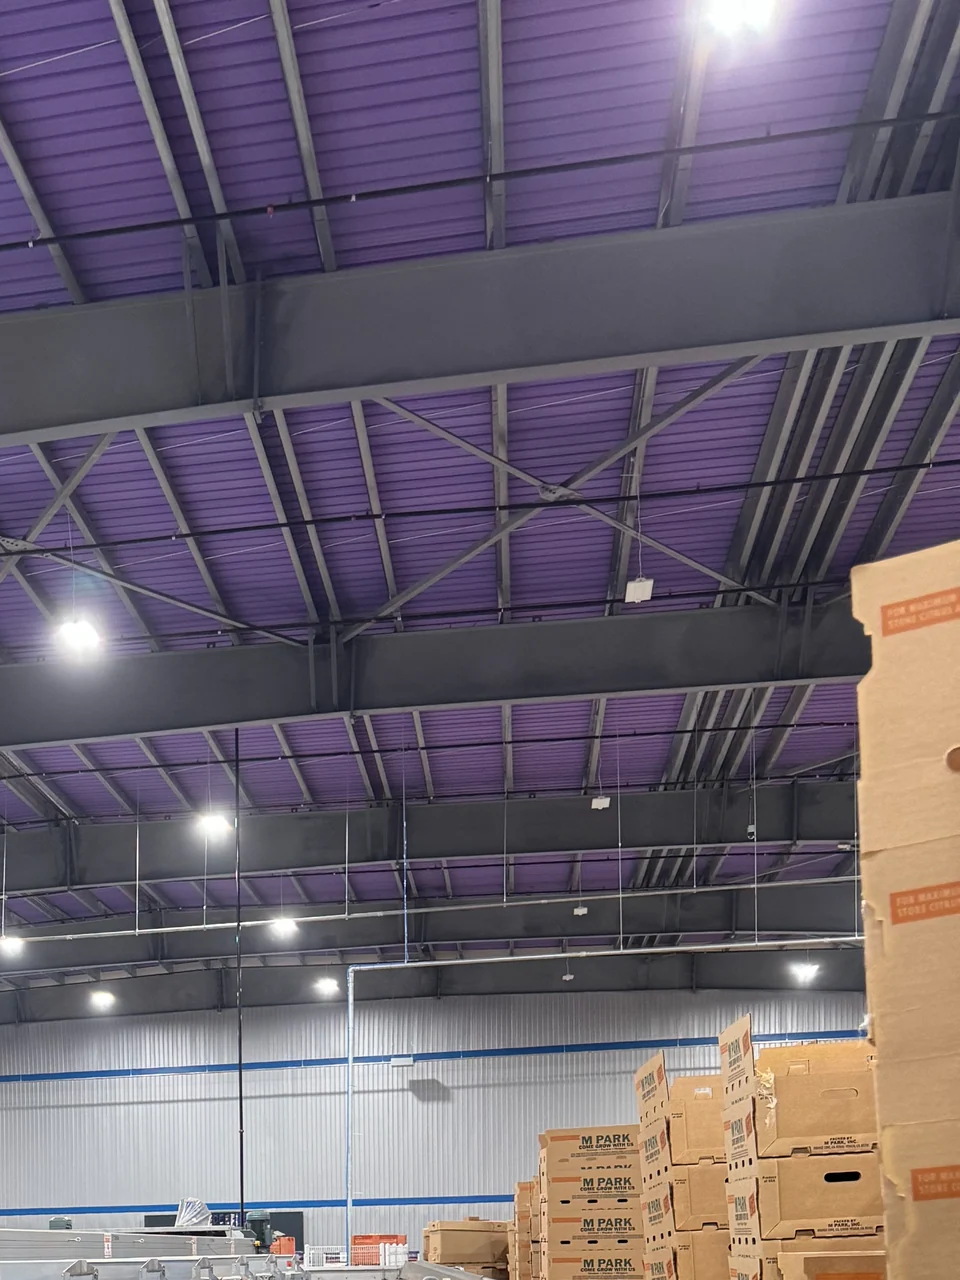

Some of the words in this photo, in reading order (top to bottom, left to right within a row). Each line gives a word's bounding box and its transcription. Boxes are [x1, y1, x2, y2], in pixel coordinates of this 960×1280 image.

[582, 1136, 593, 1145] M
[596, 1134, 631, 1144] PARK
[583, 1178, 594, 1187] M
[597, 1177, 632, 1187] PARK
[583, 1218, 594, 1228] M
[598, 1218, 633, 1228] PARK
[583, 1259, 594, 1268] M
[598, 1258, 633, 1268] PARK
